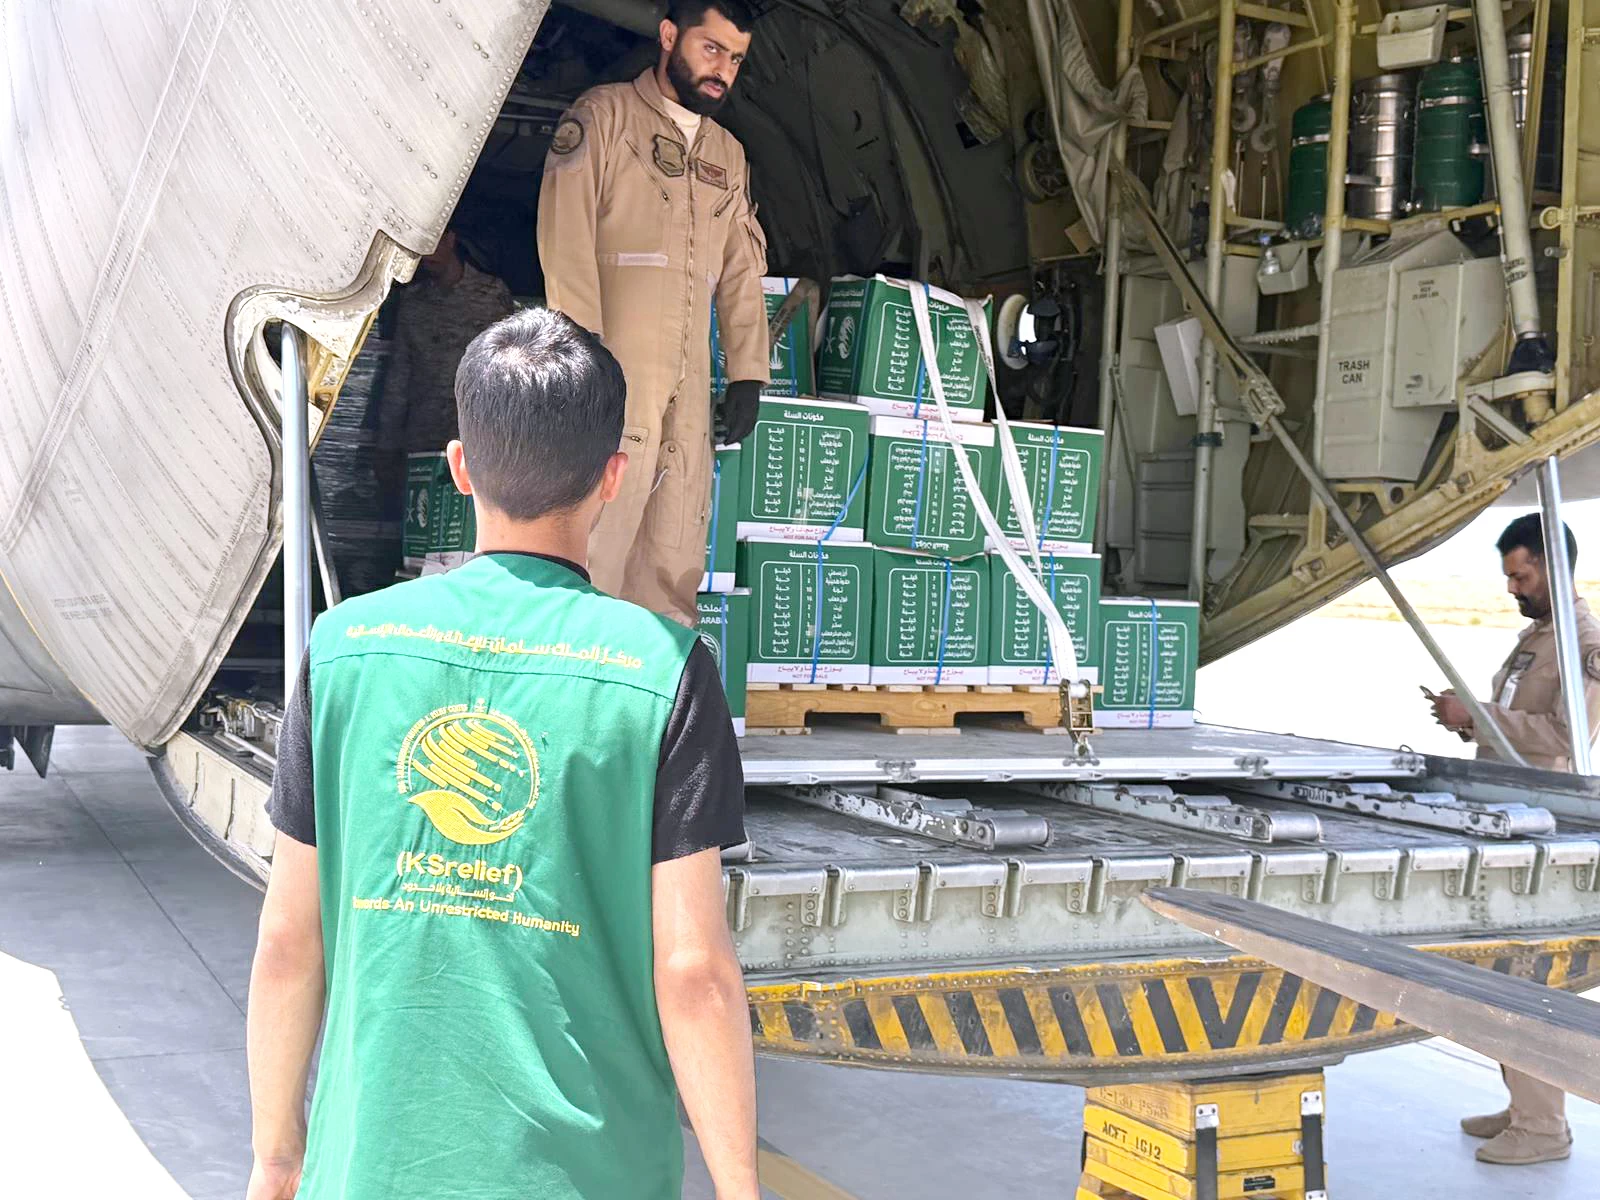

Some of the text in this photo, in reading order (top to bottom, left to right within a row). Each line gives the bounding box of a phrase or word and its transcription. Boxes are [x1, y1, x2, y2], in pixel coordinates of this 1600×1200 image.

[1338, 360, 1370, 372] TRASH
[1342, 373, 1363, 384] CAN
[784, 409, 824, 421] مكونات السلة
[789, 549, 807, 558] السلة
[489, 636, 550, 654] سلمان
[551, 642, 599, 661] الملك
[600, 647, 642, 669] مركز
[396, 851, 523, 892] (KSrelief)
[393, 899, 415, 912] An
[419, 899, 509, 922] Unrestricted
[512, 911, 580, 937] Humanity
[1102, 1121, 1128, 1144] ACFT
